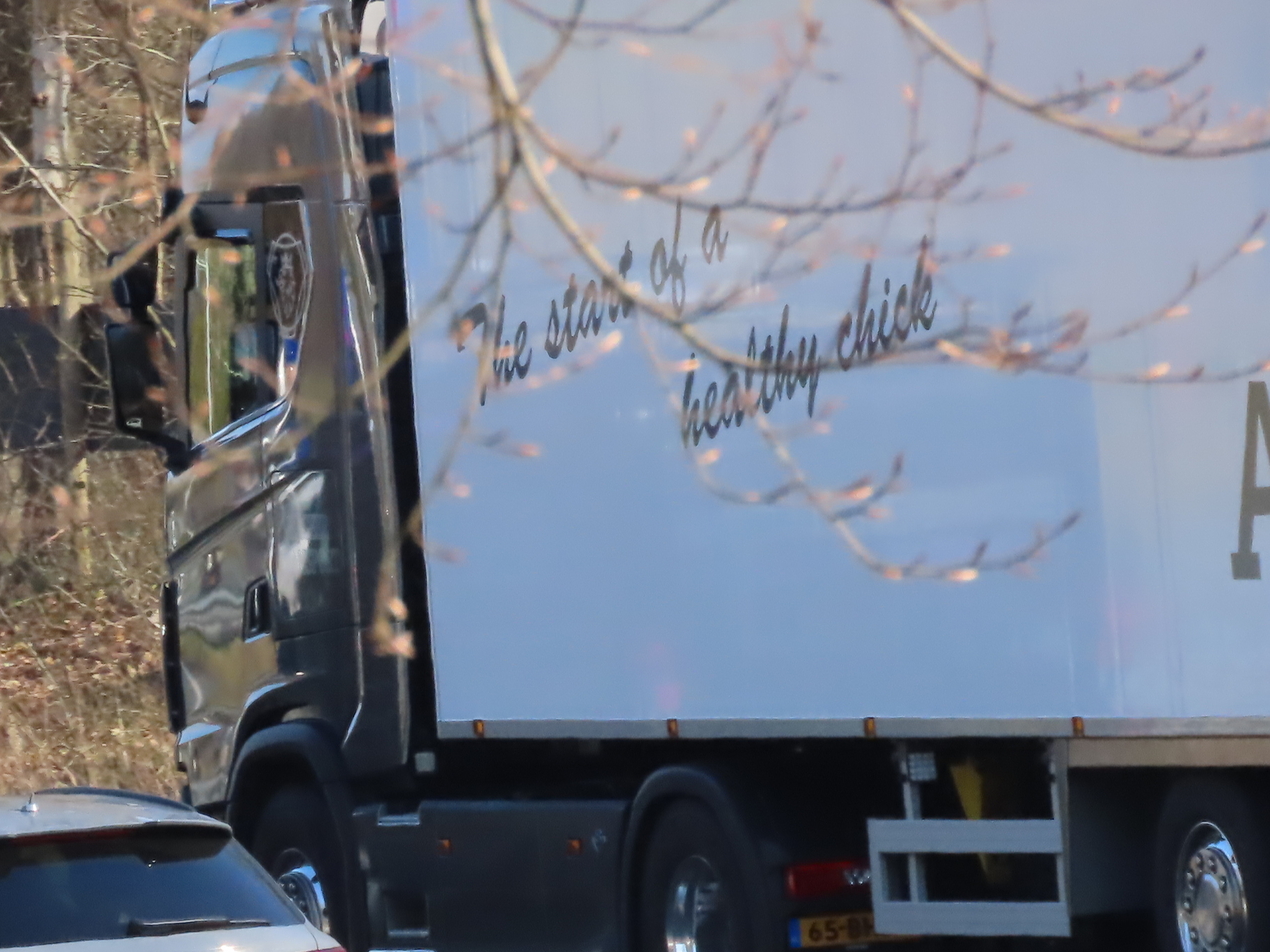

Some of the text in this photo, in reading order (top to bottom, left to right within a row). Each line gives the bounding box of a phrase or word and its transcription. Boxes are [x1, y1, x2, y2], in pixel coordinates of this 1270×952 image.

[450, 294, 532, 406] The
[650, 197, 687, 316] of
[701, 204, 728, 264] a
[682, 234, 938, 449] healthy chick
